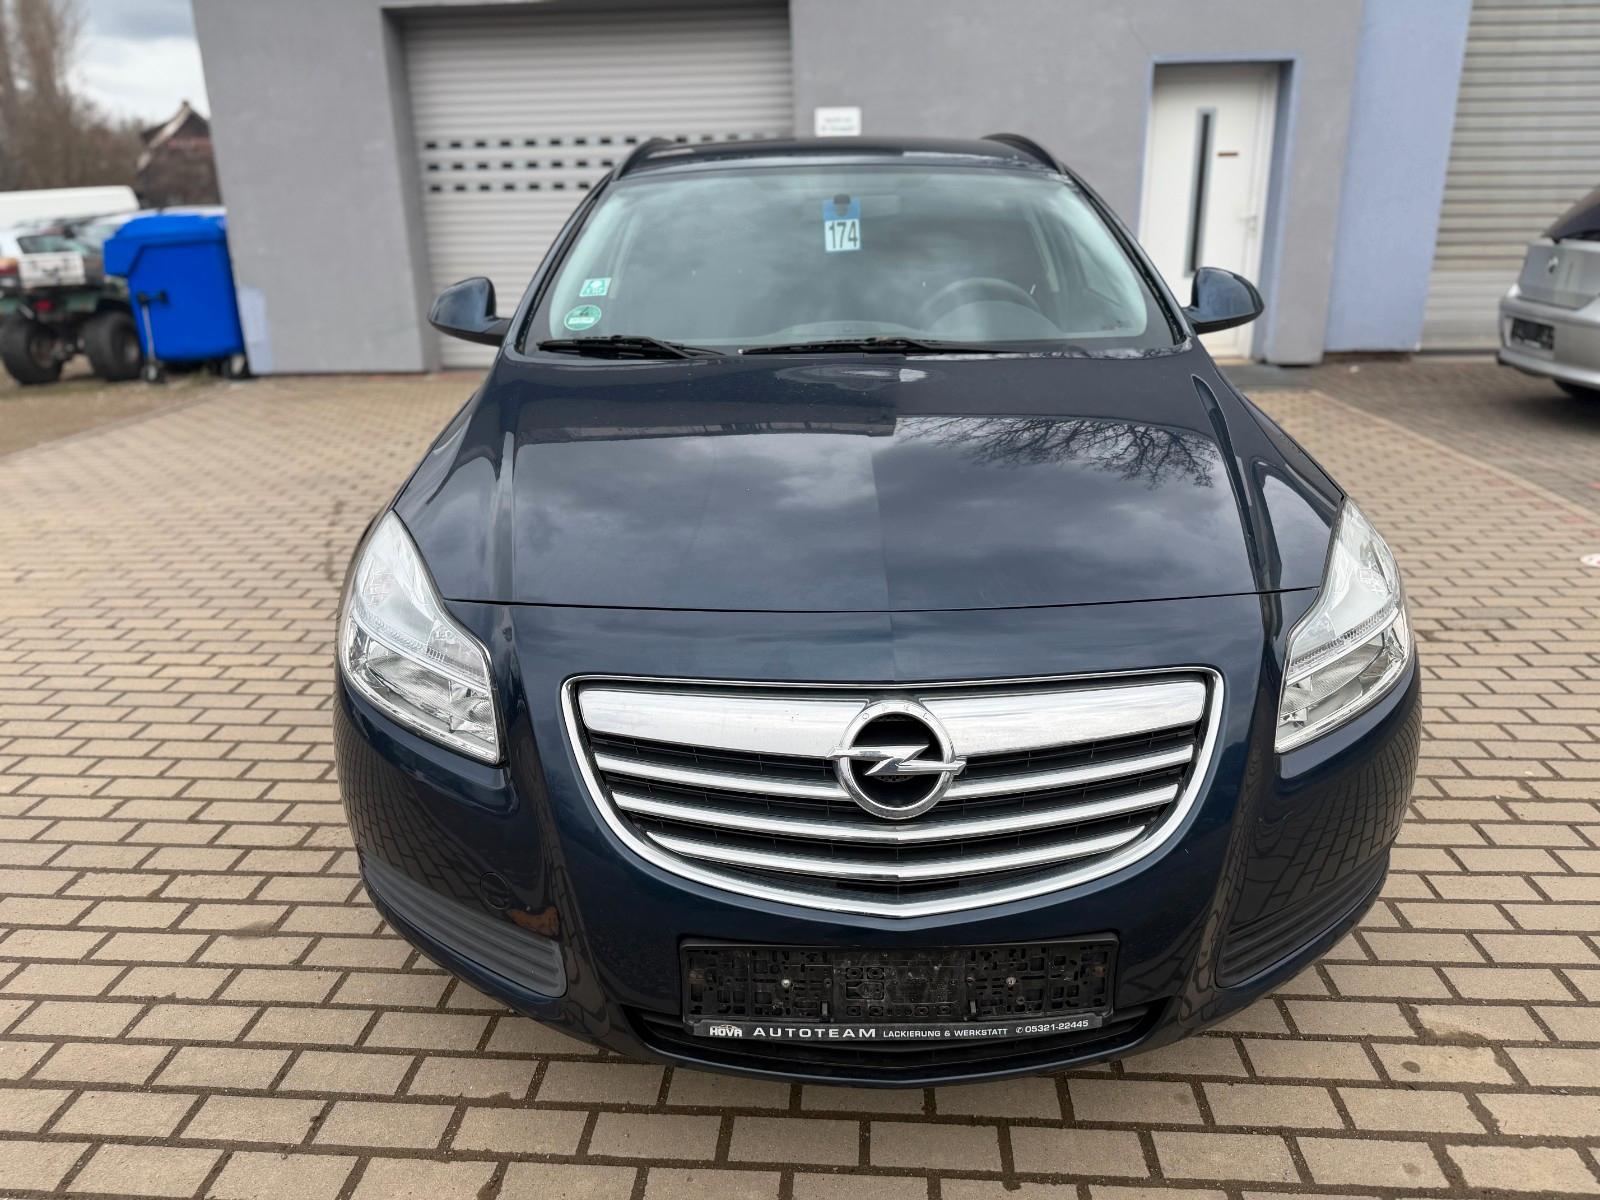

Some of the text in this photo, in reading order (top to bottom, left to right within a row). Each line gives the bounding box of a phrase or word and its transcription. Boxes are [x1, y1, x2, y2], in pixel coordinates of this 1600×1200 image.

[828, 220, 858, 249] 174
[752, 1027, 876, 1038] AUTOTEAM
[883, 1029, 941, 1038] LACKIERUNG
[954, 1028, 1008, 1037] WERKSTATT
[1024, 1019, 1089, 1033] 05321-22445
